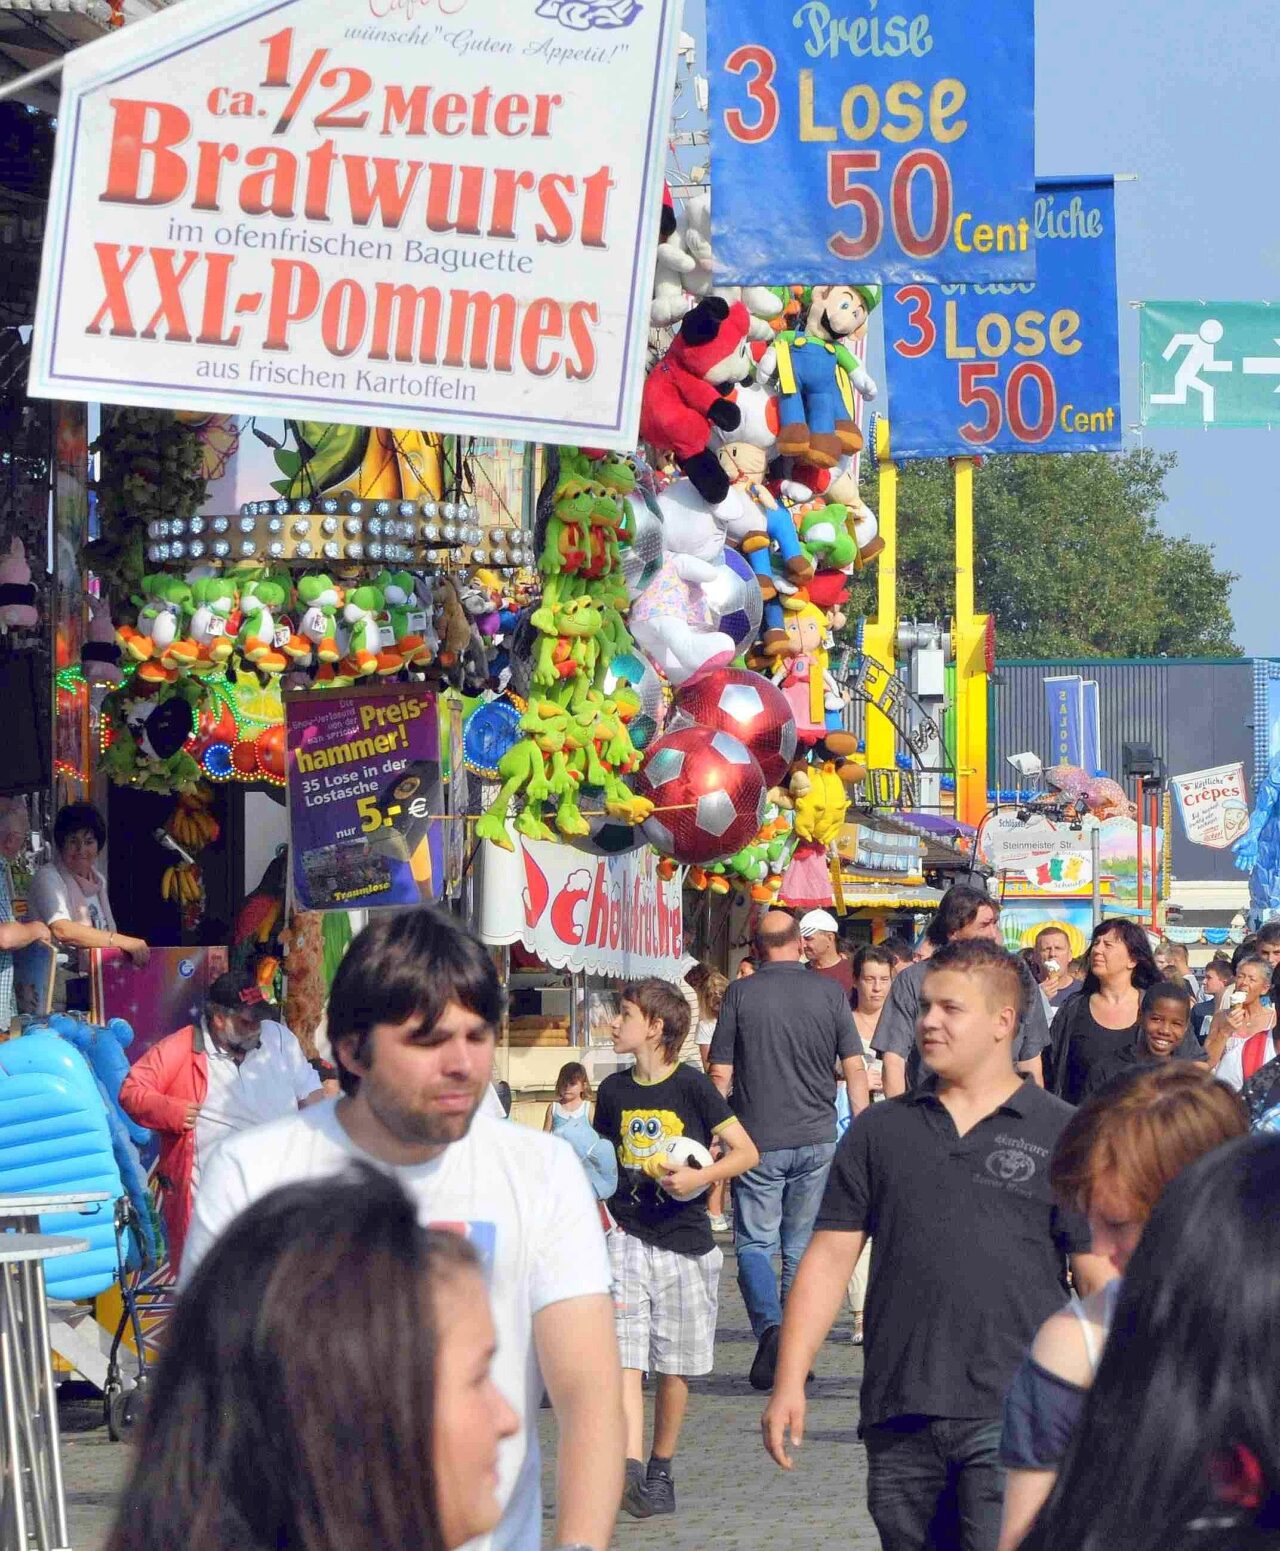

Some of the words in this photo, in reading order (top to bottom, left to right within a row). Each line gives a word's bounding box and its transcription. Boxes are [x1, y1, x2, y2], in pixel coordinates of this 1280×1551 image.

[793, 0, 934, 60] Preise
[206, 86, 268, 118] ca.
[258, 27, 374, 135] 1/2
[378, 84, 563, 138] Meter
[723, 44, 780, 144] 3
[797, 67, 968, 144] Lose
[98, 97, 618, 250] Bratwurst
[826, 148, 953, 260] 50
[953, 213, 1031, 254] Cent
[1034, 196, 1103, 239] liche
[168, 217, 203, 244] im
[213, 221, 394, 262] ofenfrischen
[403, 240, 534, 275] Baguette
[84, 241, 601, 382] XXL-Pommes
[893, 285, 937, 358] 3
[944, 301, 1083, 359] Lose
[196, 358, 240, 380] aus
[249, 358, 347, 392] frischen
[355, 368, 477, 402] Kartoffeln
[957, 361, 1056, 444] 50
[1060, 403, 1115, 434] Cent
[360, 695, 428, 731] Preis-
[295, 723, 409, 773] hammer!
[302, 779, 320, 793] 35
[325, 771, 358, 788] Lose
[363, 766, 378, 778] in
[382, 758, 407, 773] der
[305, 780, 379, 807] Lostasche
[1183, 786, 1240, 807] Crêpes
[336, 827, 357, 839] nur
[408, 797, 429, 818] €
[1002, 841, 1055, 850] Steinmeister
[334, 881, 391, 901] Traumlose
